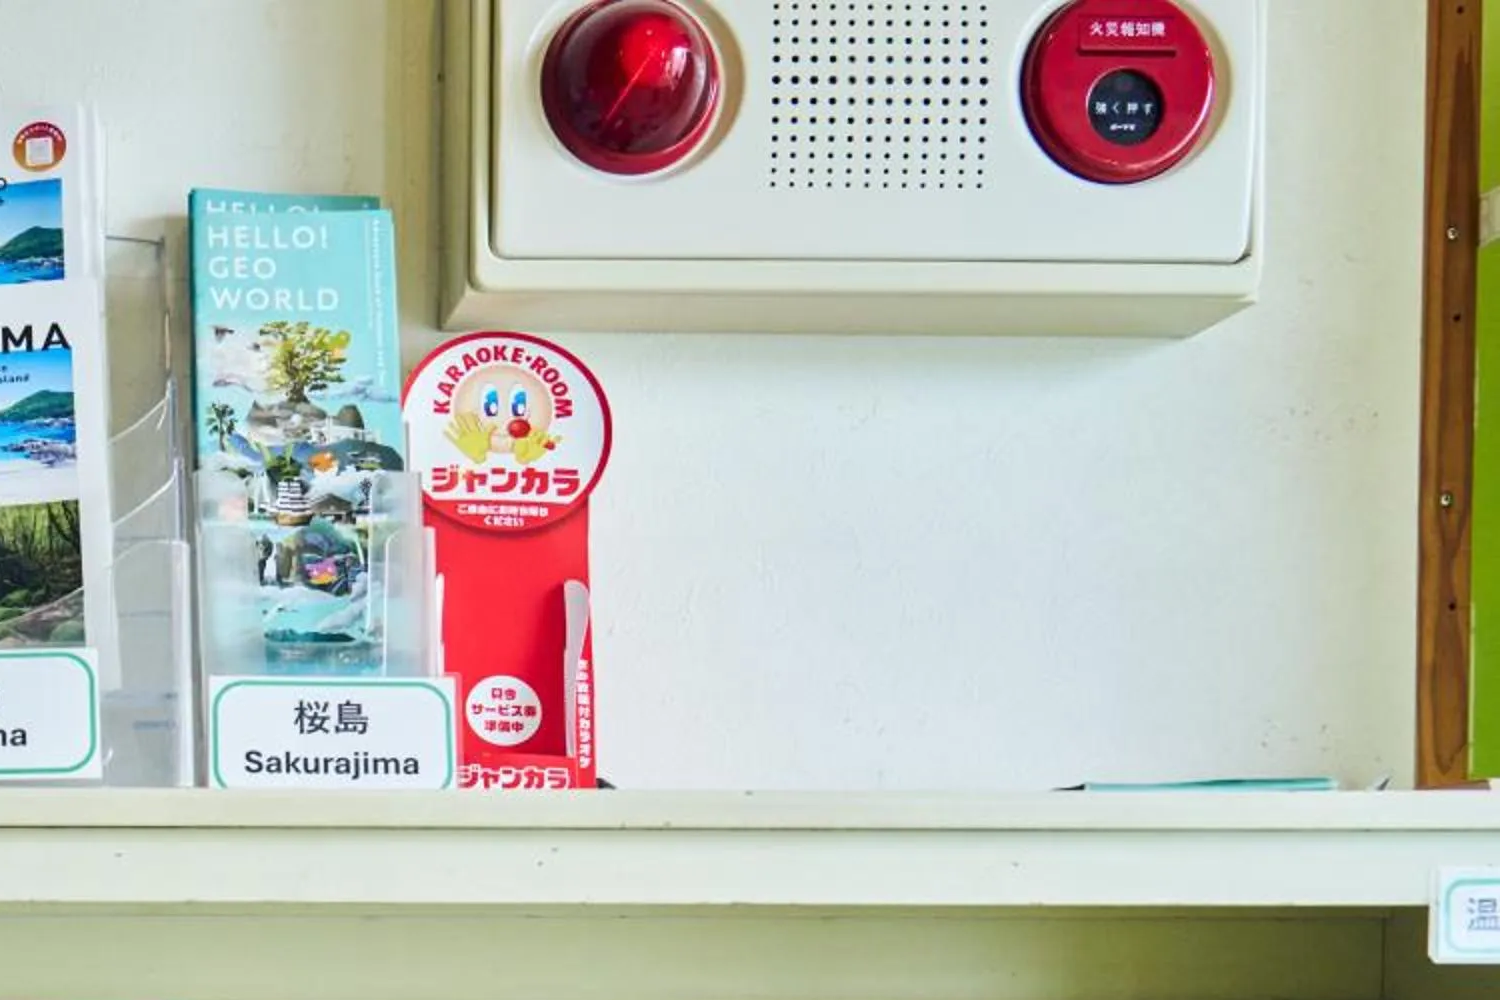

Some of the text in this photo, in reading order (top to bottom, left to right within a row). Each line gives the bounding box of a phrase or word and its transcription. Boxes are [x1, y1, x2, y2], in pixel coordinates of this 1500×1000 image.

[1095, 101, 1154, 116] 強く押す
[208, 226, 328, 249] HELLO!
[209, 256, 277, 280] GEO
[210, 288, 340, 311] WORLD
[431, 463, 581, 497] ジャンカラ
[293, 700, 369, 735] 桜島
[245, 751, 420, 780] Sakurajima
[457, 763, 570, 790] ジャンカラ
[1468, 897, 1500, 931] 温
